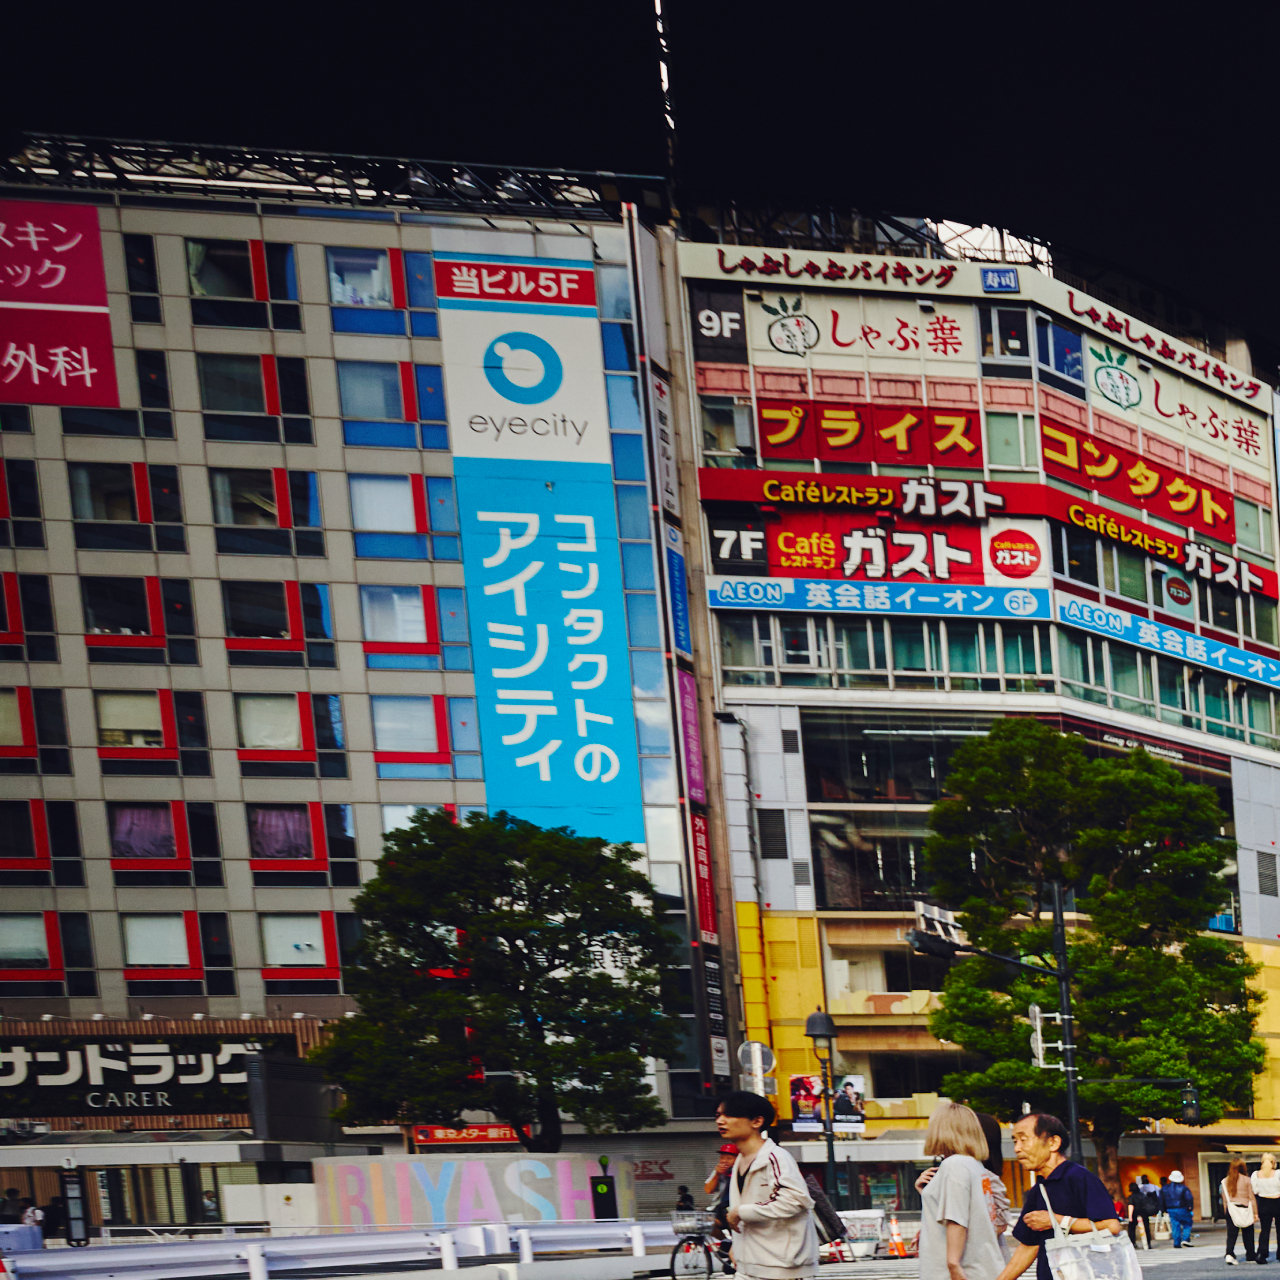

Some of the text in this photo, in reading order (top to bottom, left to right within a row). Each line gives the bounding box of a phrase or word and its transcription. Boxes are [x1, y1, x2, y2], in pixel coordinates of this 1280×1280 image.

[0, 258, 67, 289] ック
[451, 264, 579, 299] 当ビル5F
[716, 248, 957, 289] しゃぶしゃぶバイキング
[983, 271, 1017, 290] 寿司
[698, 308, 741, 339] 9F
[830, 309, 963, 356] しゃぶ葉
[1, 341, 98, 388] 外科
[468, 411, 589, 446] eyecity
[761, 405, 977, 453] プライス
[1153, 378, 1262, 457] しゃぶ葉
[1042, 424, 1228, 525] コンタクト
[900, 477, 1005, 518] ガスト
[713, 529, 765, 561] 7F
[777, 531, 836, 555] Café
[843, 527, 972, 580] ガスト
[994, 549, 1038, 567] ガスト
[780, 556, 836, 570] レストラン
[1184, 541, 1264, 593] ガスト
[718, 581, 785, 604] AEON
[805, 583, 994, 612] 英会話イーオン
[1066, 601, 1124, 634] AEON
[475, 510, 566, 782] アイシティ
[553, 512, 621, 784] コンタクトの
[0, 1042, 263, 1087] サンドラッグ
[86, 1091, 172, 1109] CARER
